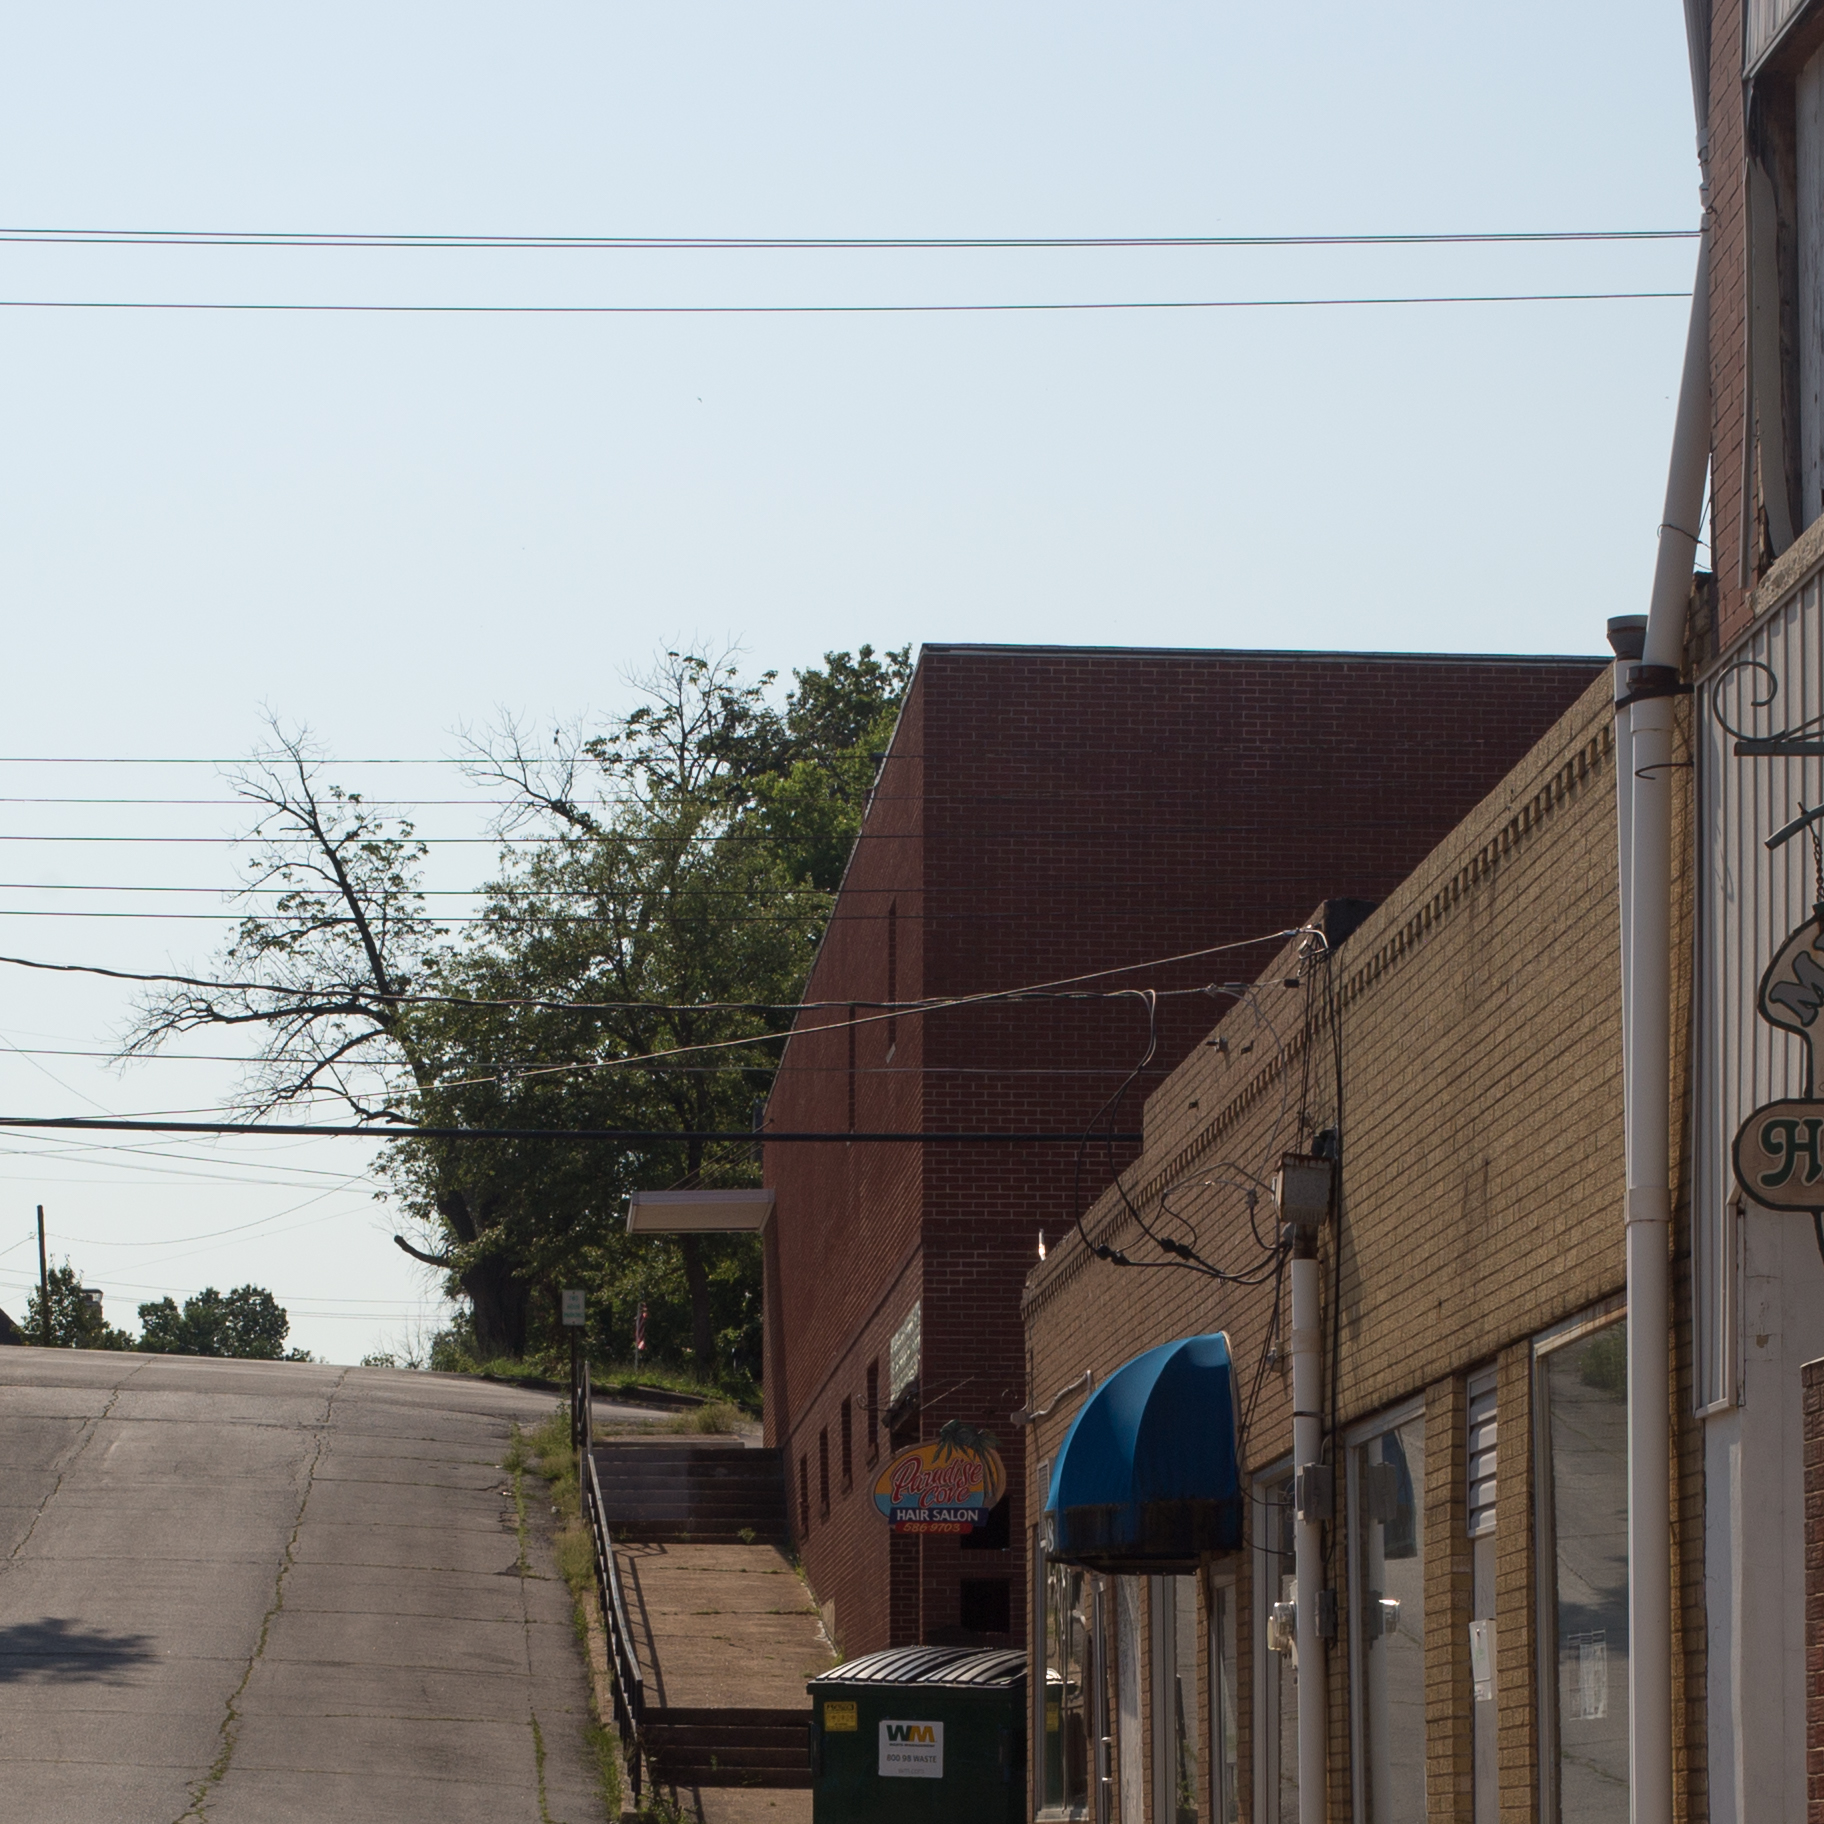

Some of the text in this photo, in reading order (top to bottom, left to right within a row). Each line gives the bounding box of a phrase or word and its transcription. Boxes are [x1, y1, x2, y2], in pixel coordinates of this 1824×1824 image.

[891, 1456, 983, 1503] Paradise
[919, 1486, 971, 1508] Cove
[897, 1509, 979, 1521] HAIR SALON
[886, 1725, 935, 1742] WM
[887, 1754, 900, 1762] 800
[913, 1755, 937, 1763] WASTE
